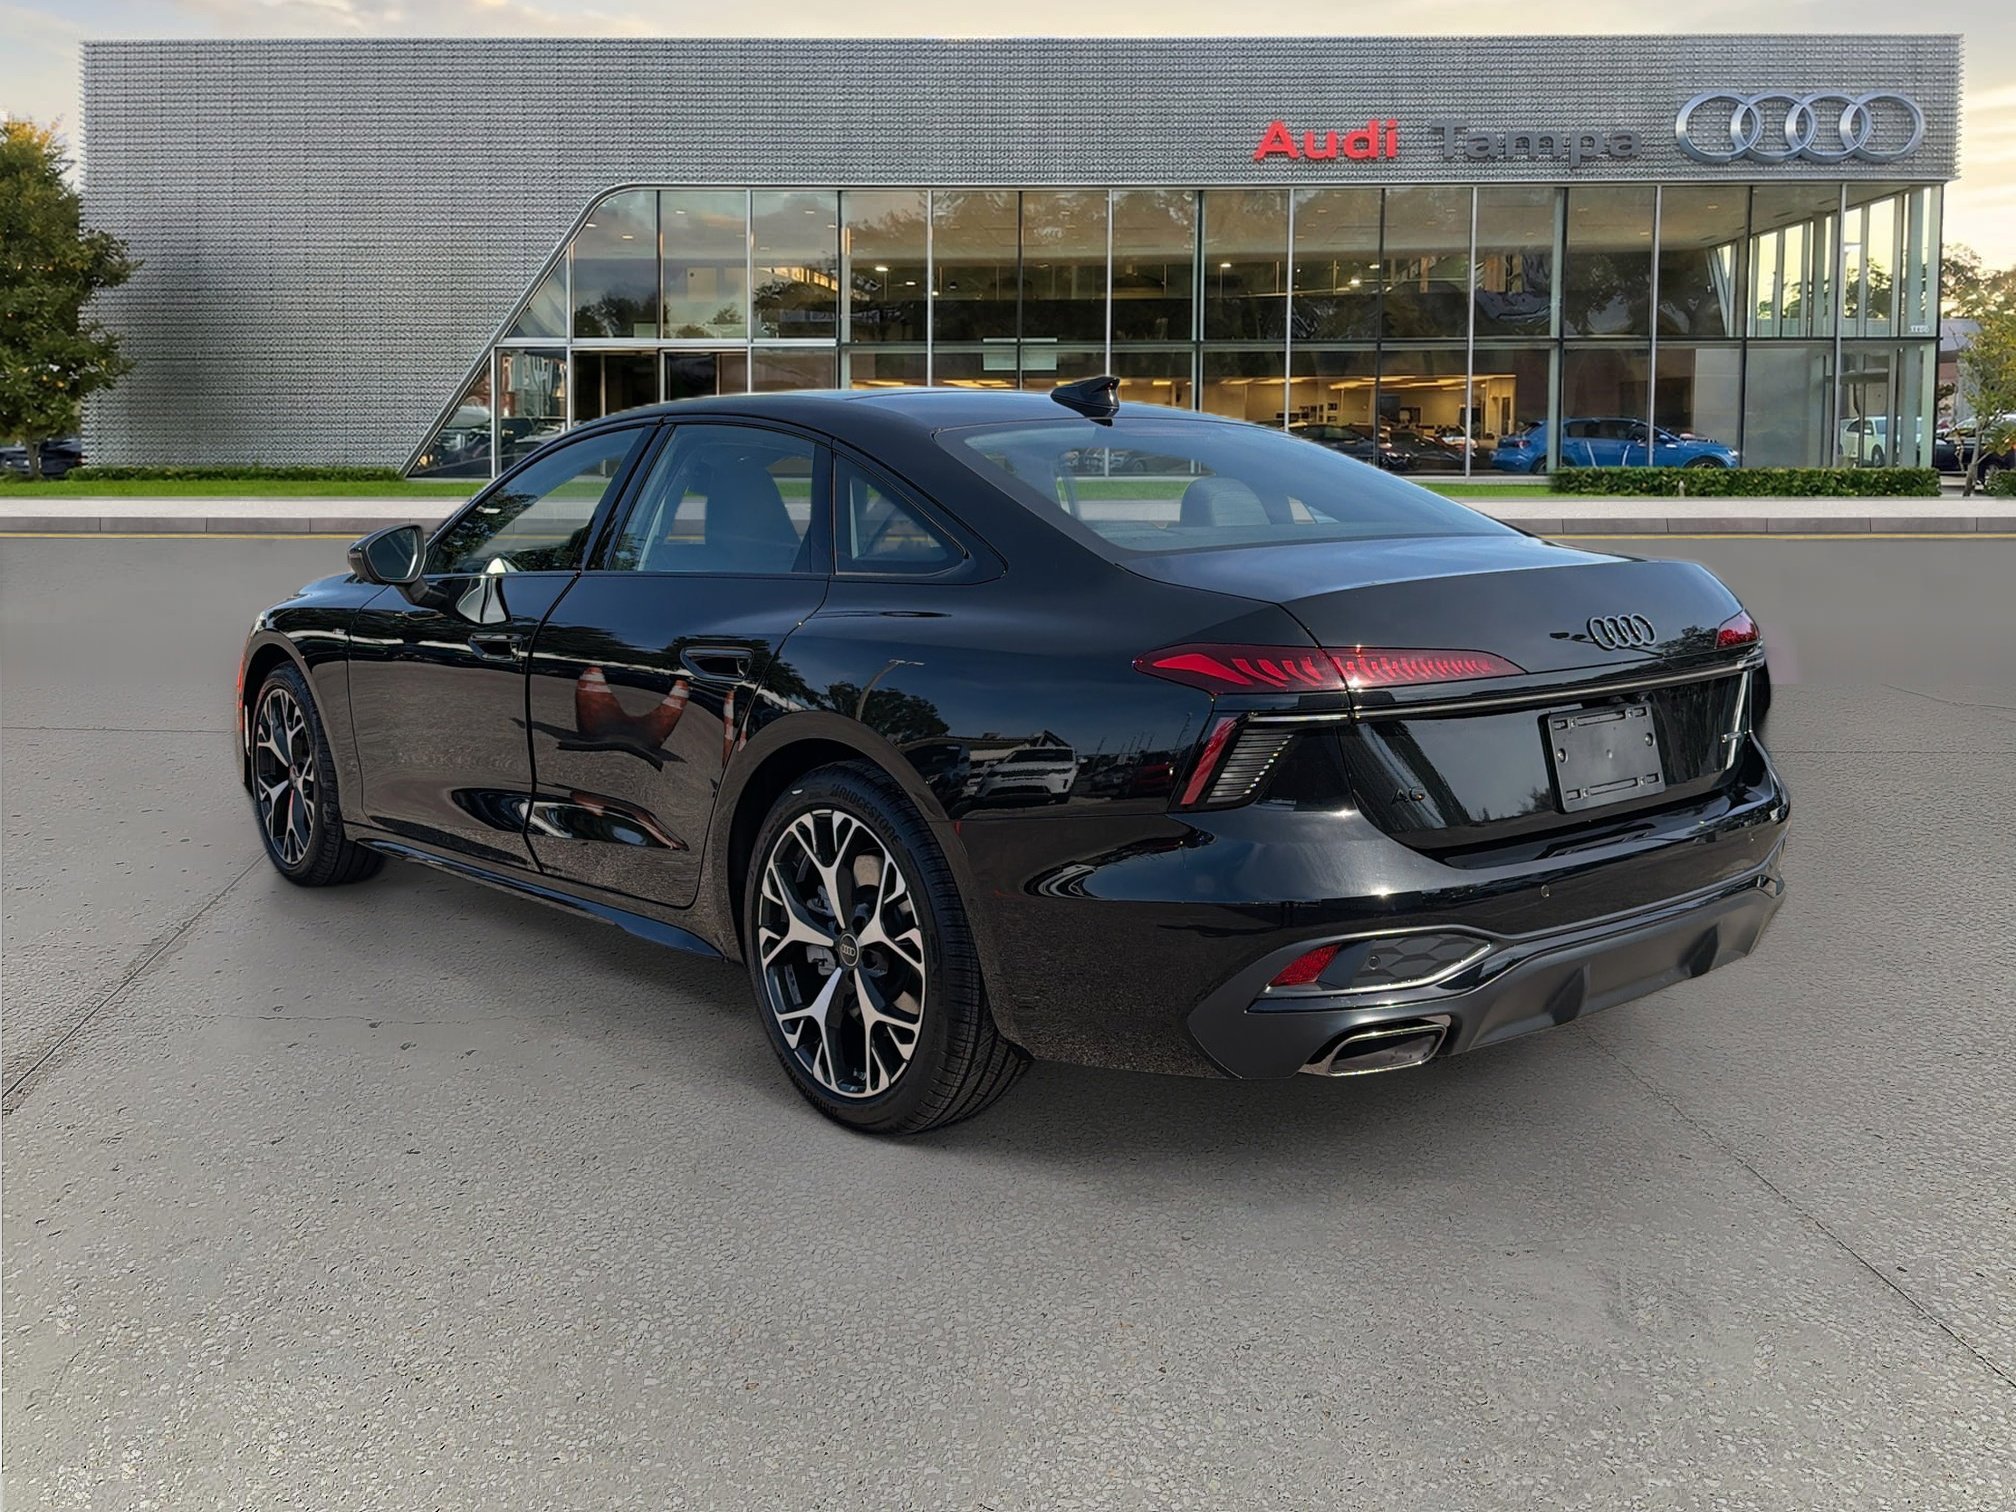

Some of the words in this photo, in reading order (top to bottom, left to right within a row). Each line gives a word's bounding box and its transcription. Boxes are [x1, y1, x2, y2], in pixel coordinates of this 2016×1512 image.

[1253, 119, 1398, 161] Audi
[1431, 119, 1643, 169] Tampa
[1391, 785, 1426, 804] A6
